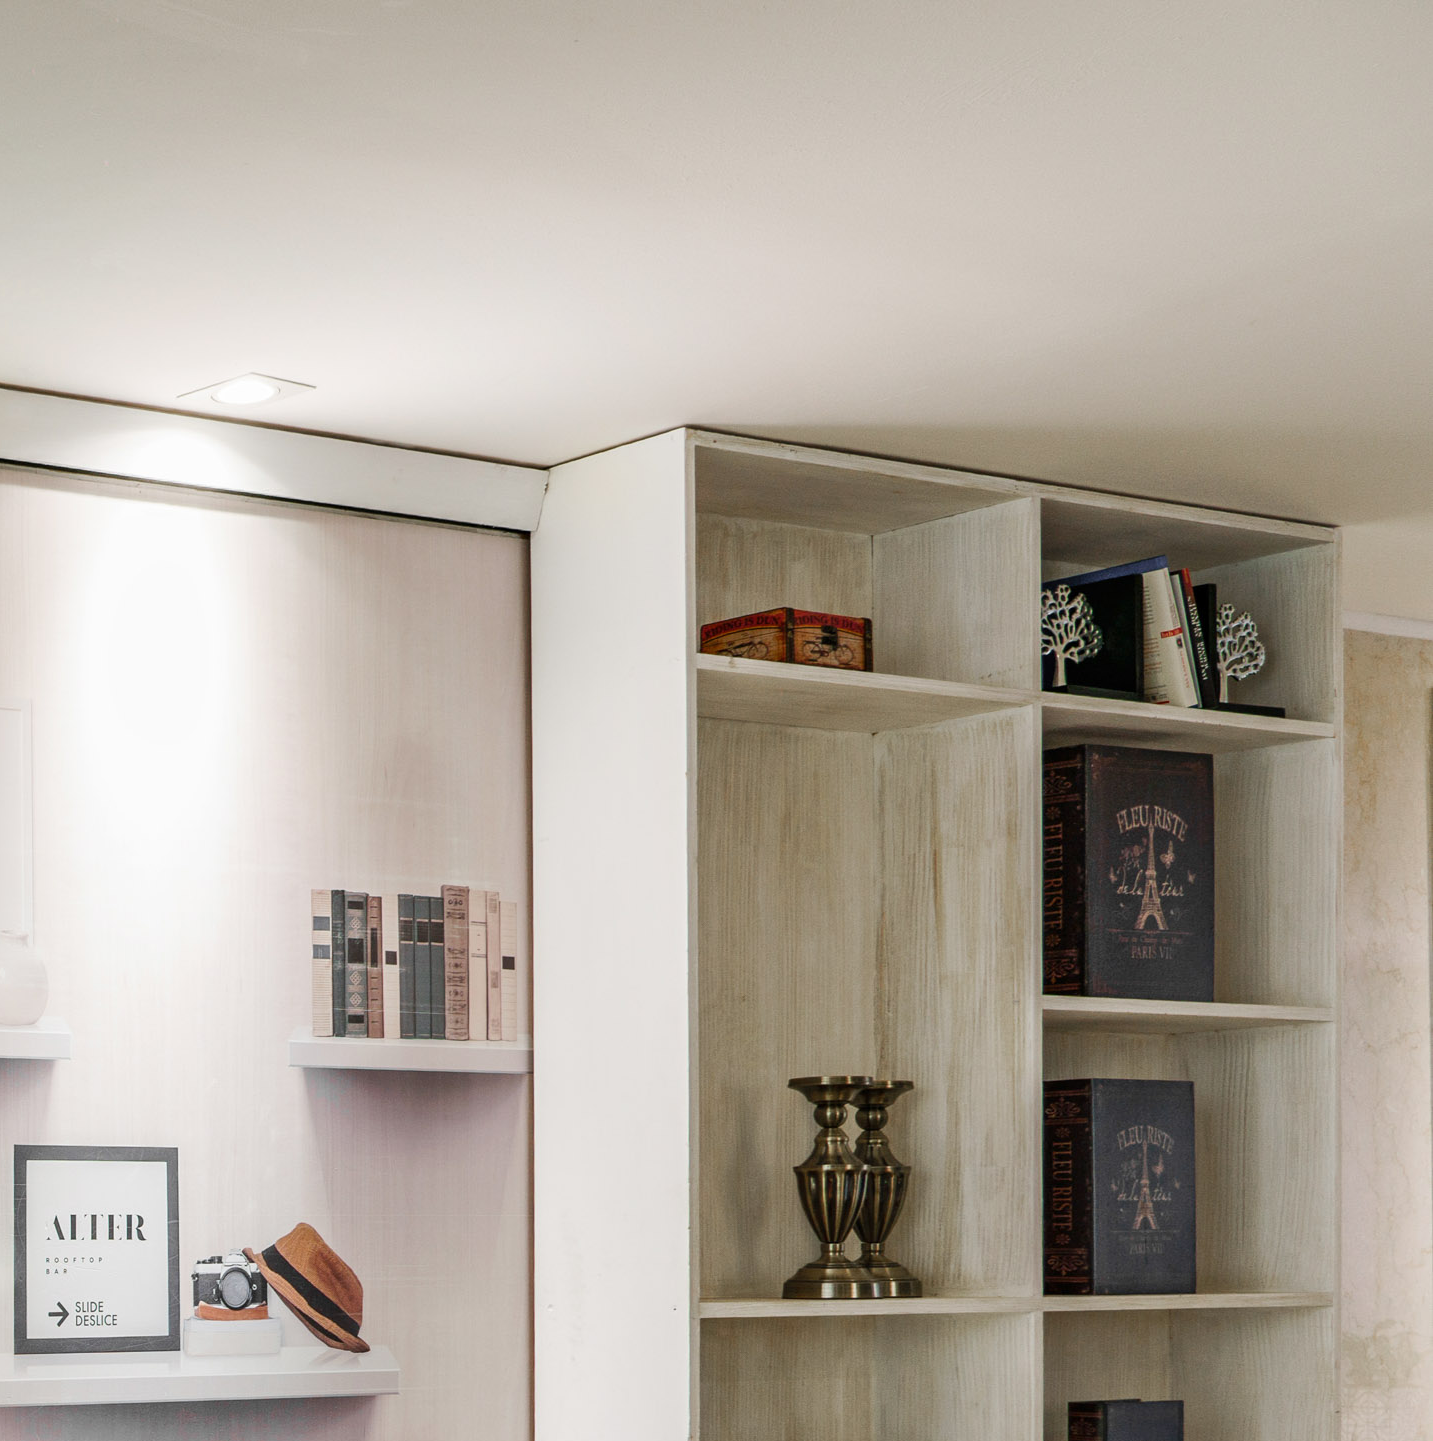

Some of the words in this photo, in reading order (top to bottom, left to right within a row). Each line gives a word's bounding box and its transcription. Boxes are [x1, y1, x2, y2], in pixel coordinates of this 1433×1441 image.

[46, 1214, 147, 1241] ALTER
[75, 1301, 104, 1313] SLIDE
[75, 1314, 118, 1327] DESLICE
